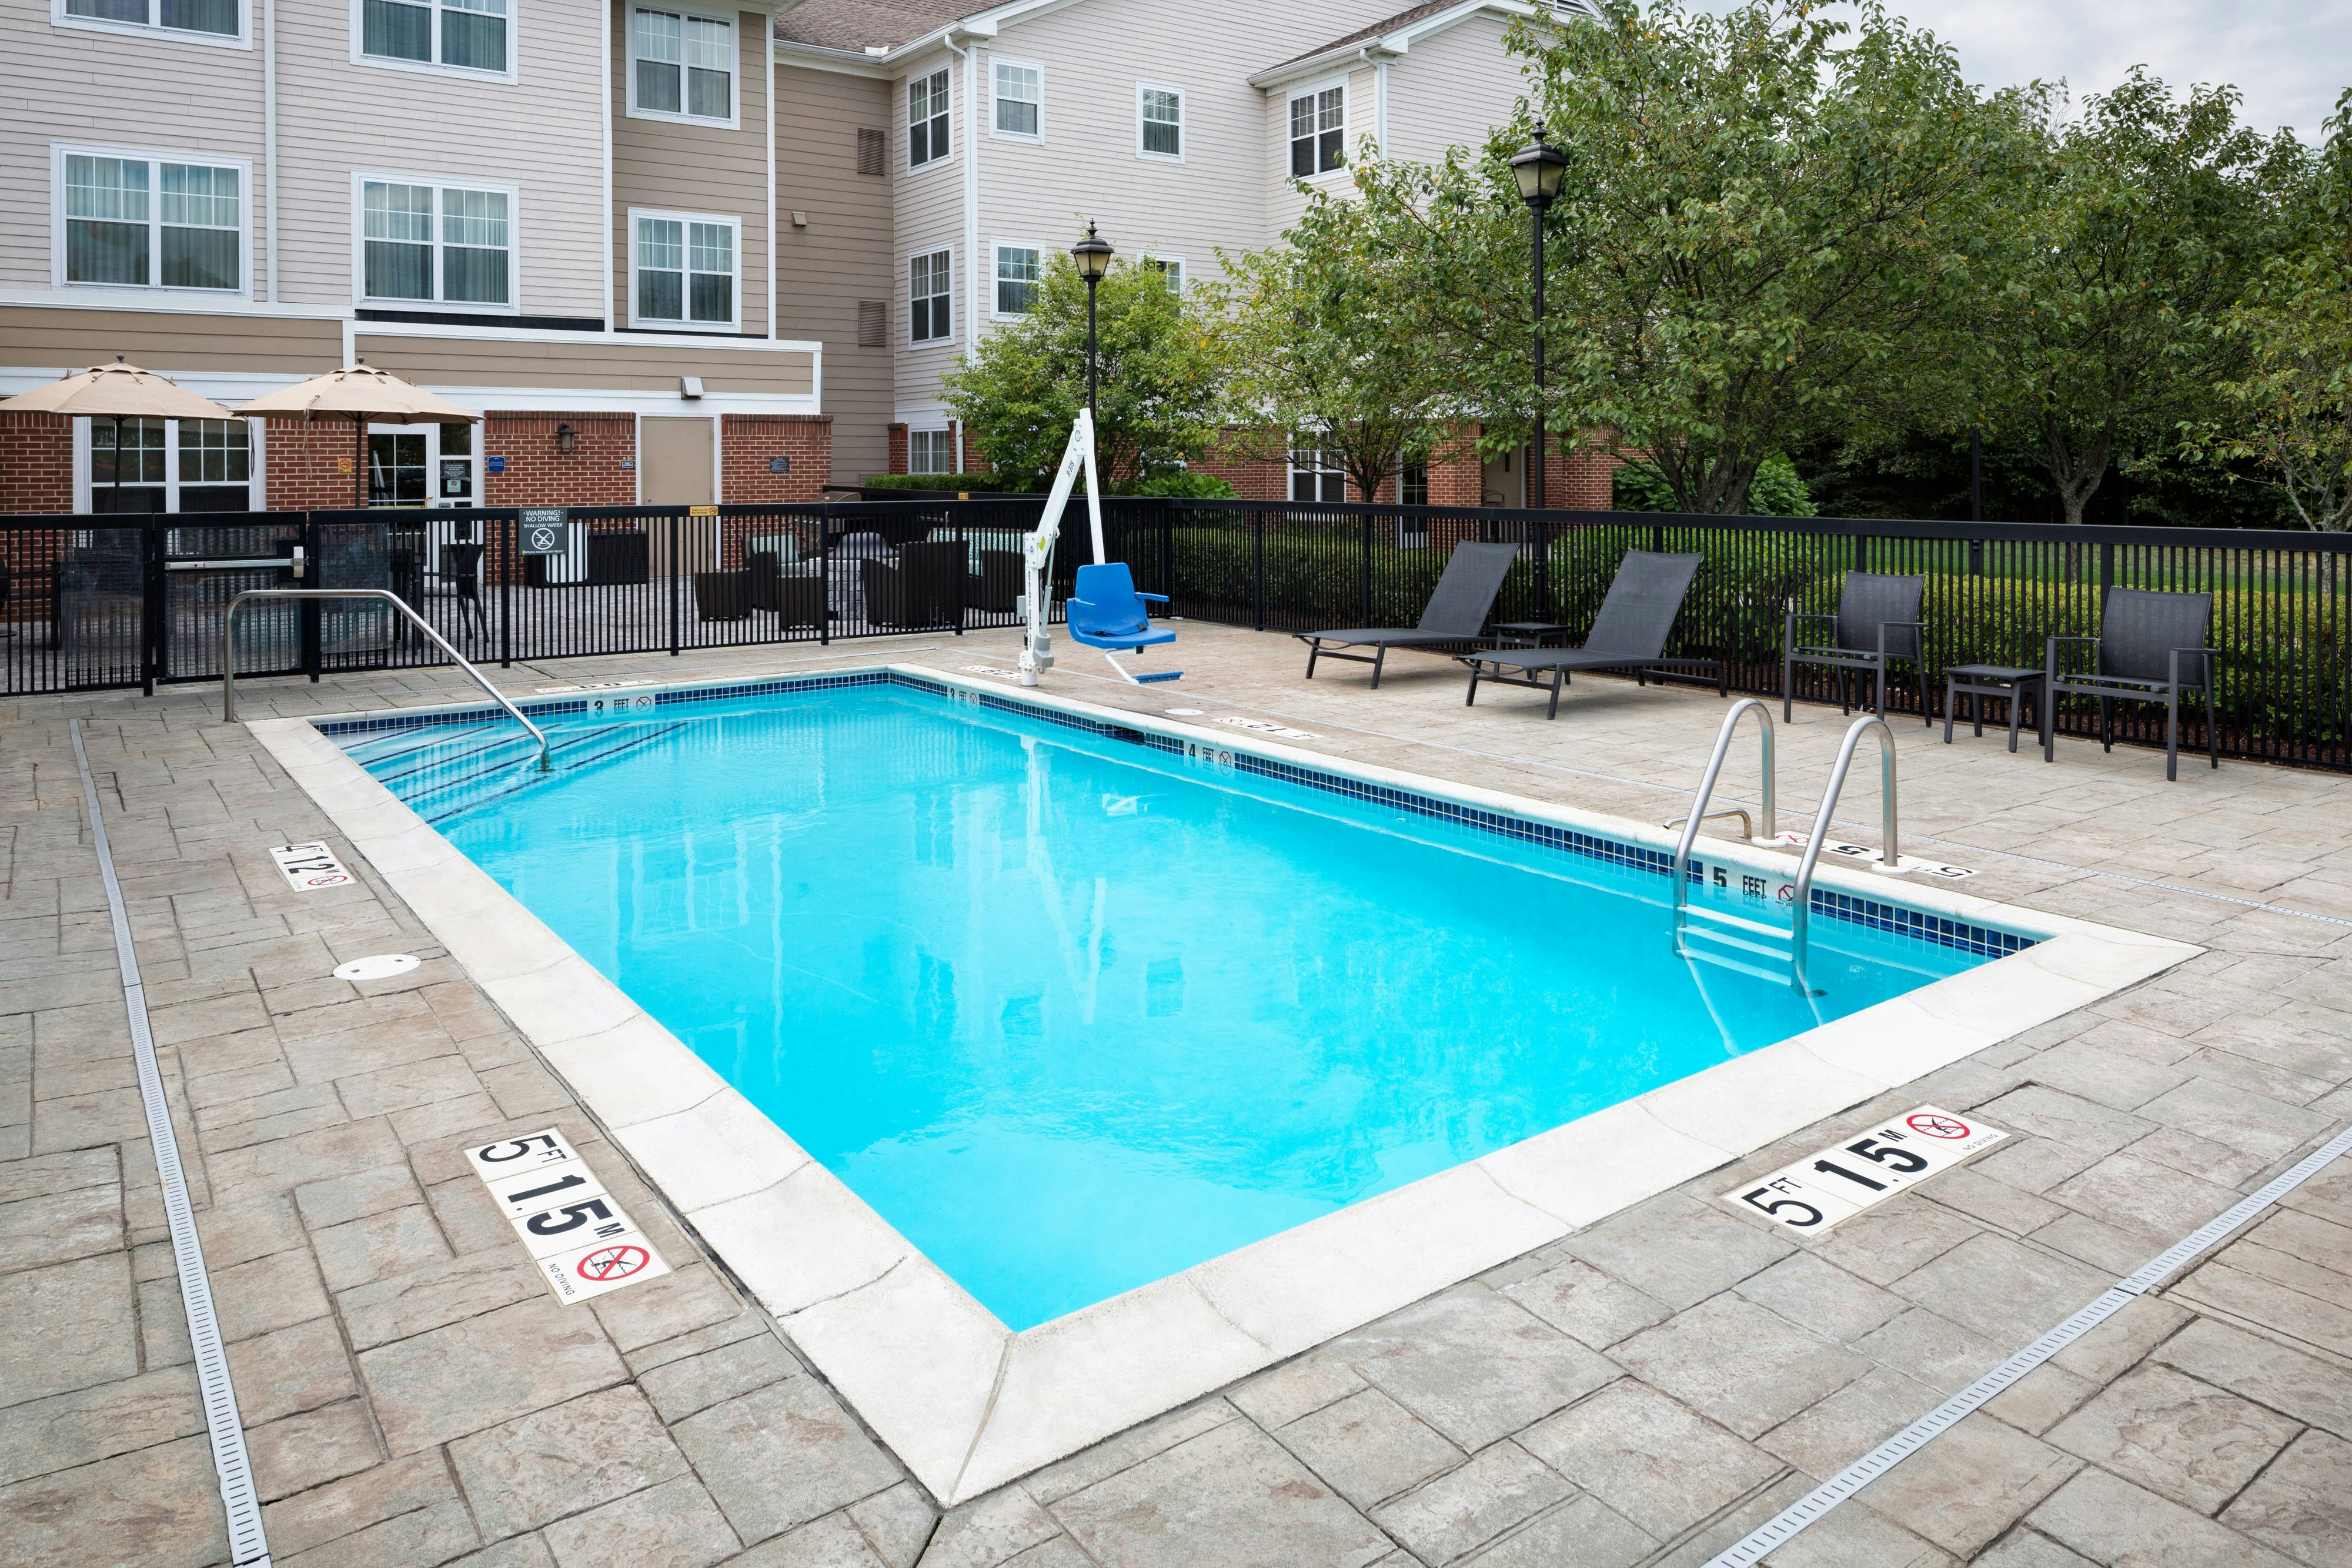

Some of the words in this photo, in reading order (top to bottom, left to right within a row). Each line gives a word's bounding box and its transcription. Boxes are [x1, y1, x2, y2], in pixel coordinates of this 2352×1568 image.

[950, 688, 955, 698] 3
[594, 700, 604, 710] 3
[614, 698, 629, 709] FEET
[1189, 743, 1196, 757] 4
[1203, 747, 1214, 762] FEET
[1713, 867, 1728, 888] 5
[1743, 875, 1766, 895] FEET
[1743, 890, 1768, 900] DEEP
[1975, 1134, 1998, 1146] DIVING
[548, 1263, 560, 1273] NO
[555, 1273, 575, 1295] DIVING
